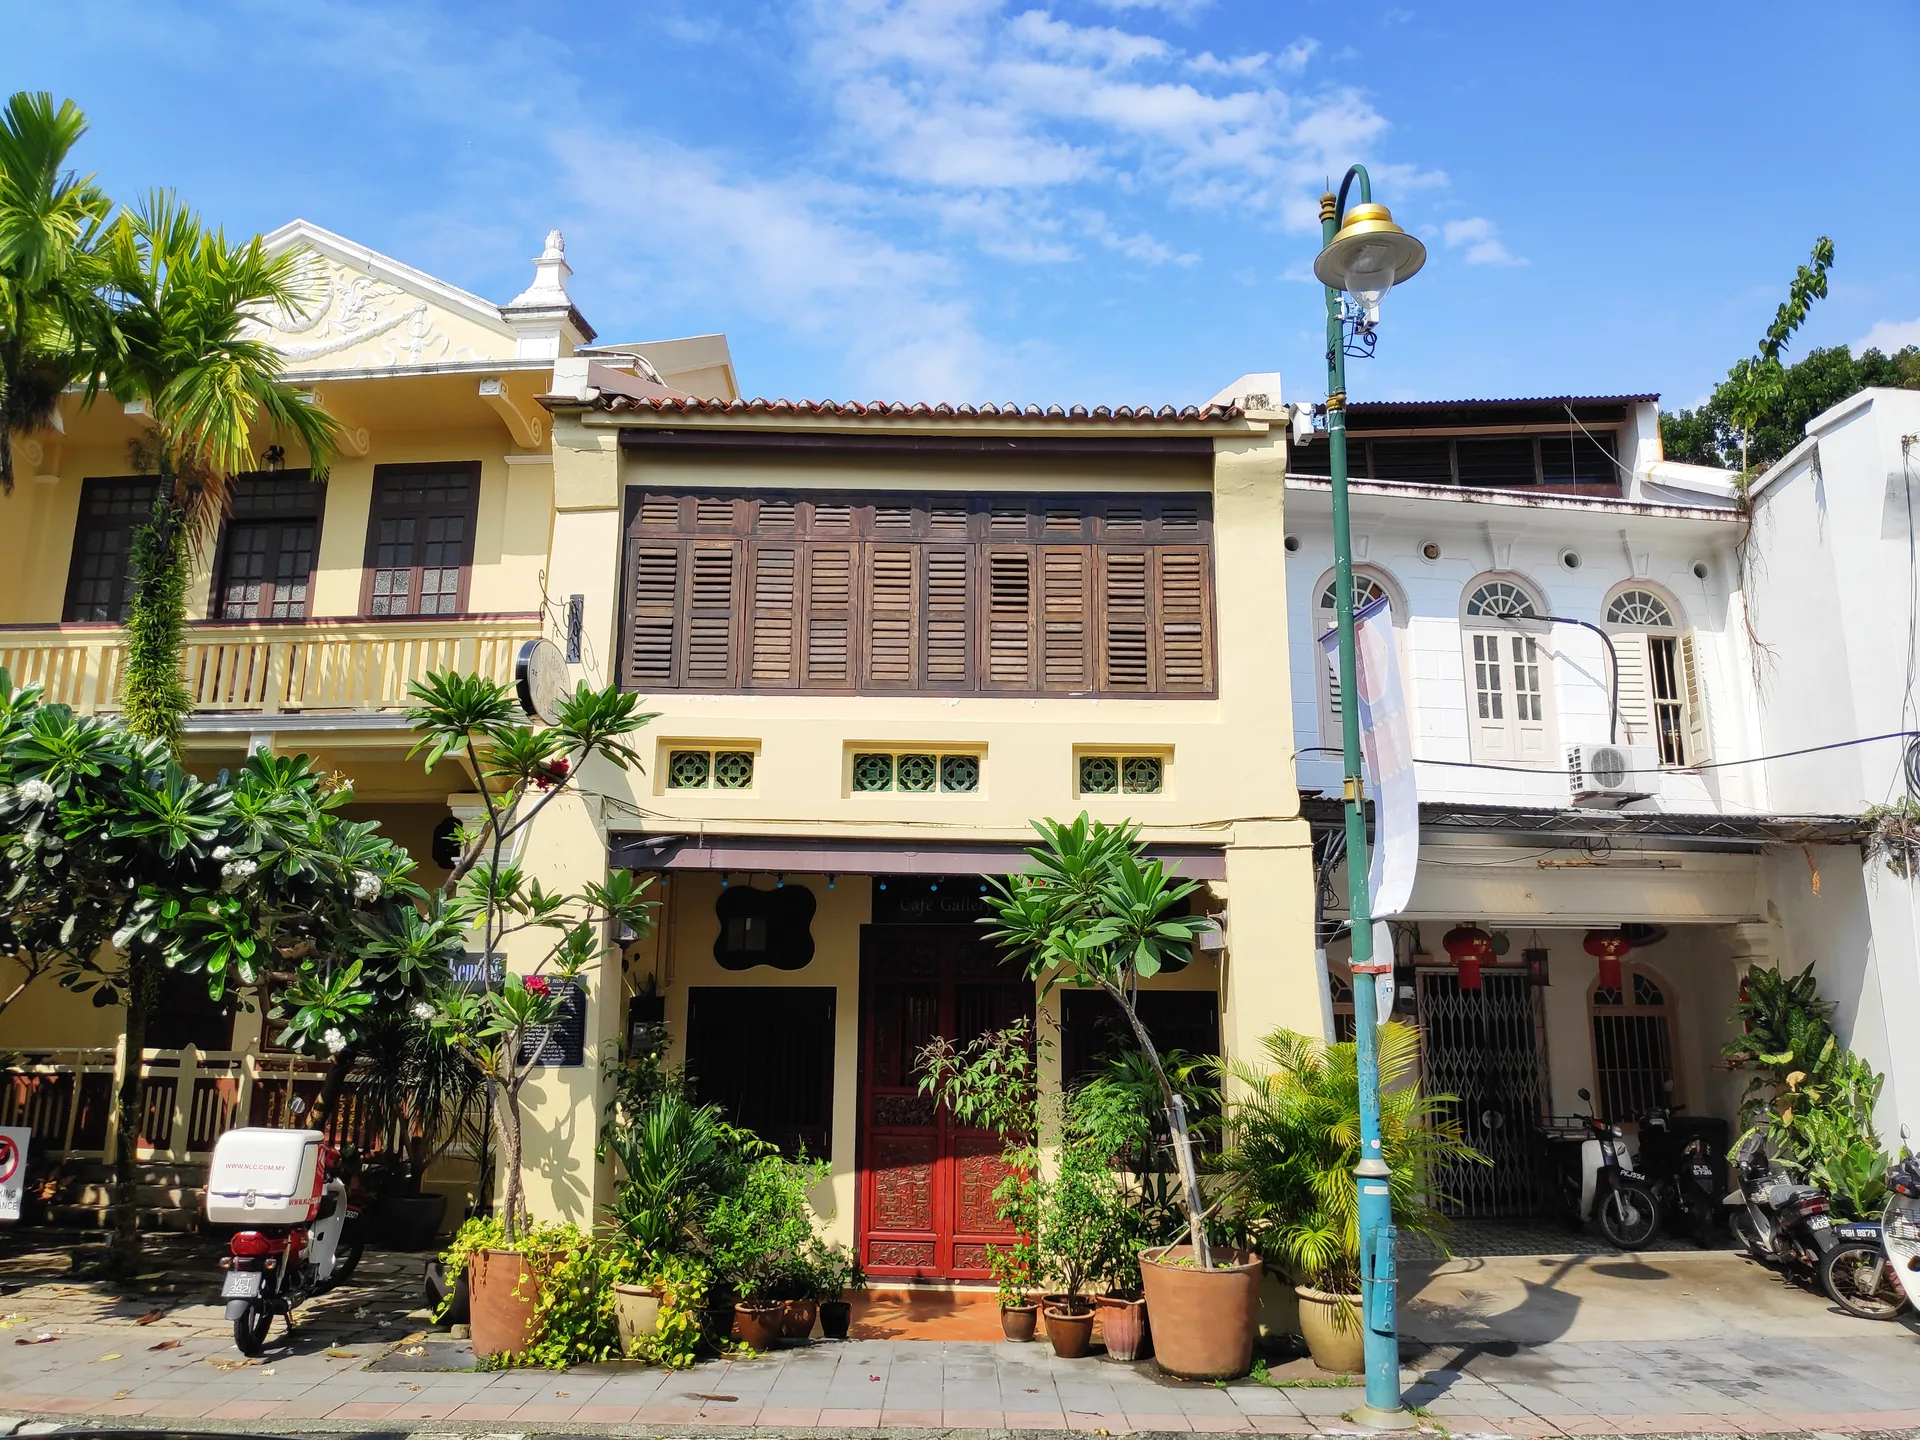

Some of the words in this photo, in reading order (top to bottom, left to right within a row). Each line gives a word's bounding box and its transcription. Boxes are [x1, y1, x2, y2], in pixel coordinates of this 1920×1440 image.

[225, 1163, 286, 1172] WWW.NLC.COM.MY
[234, 1277, 252, 1286] VCT
[229, 1286, 252, 1294] 3921
